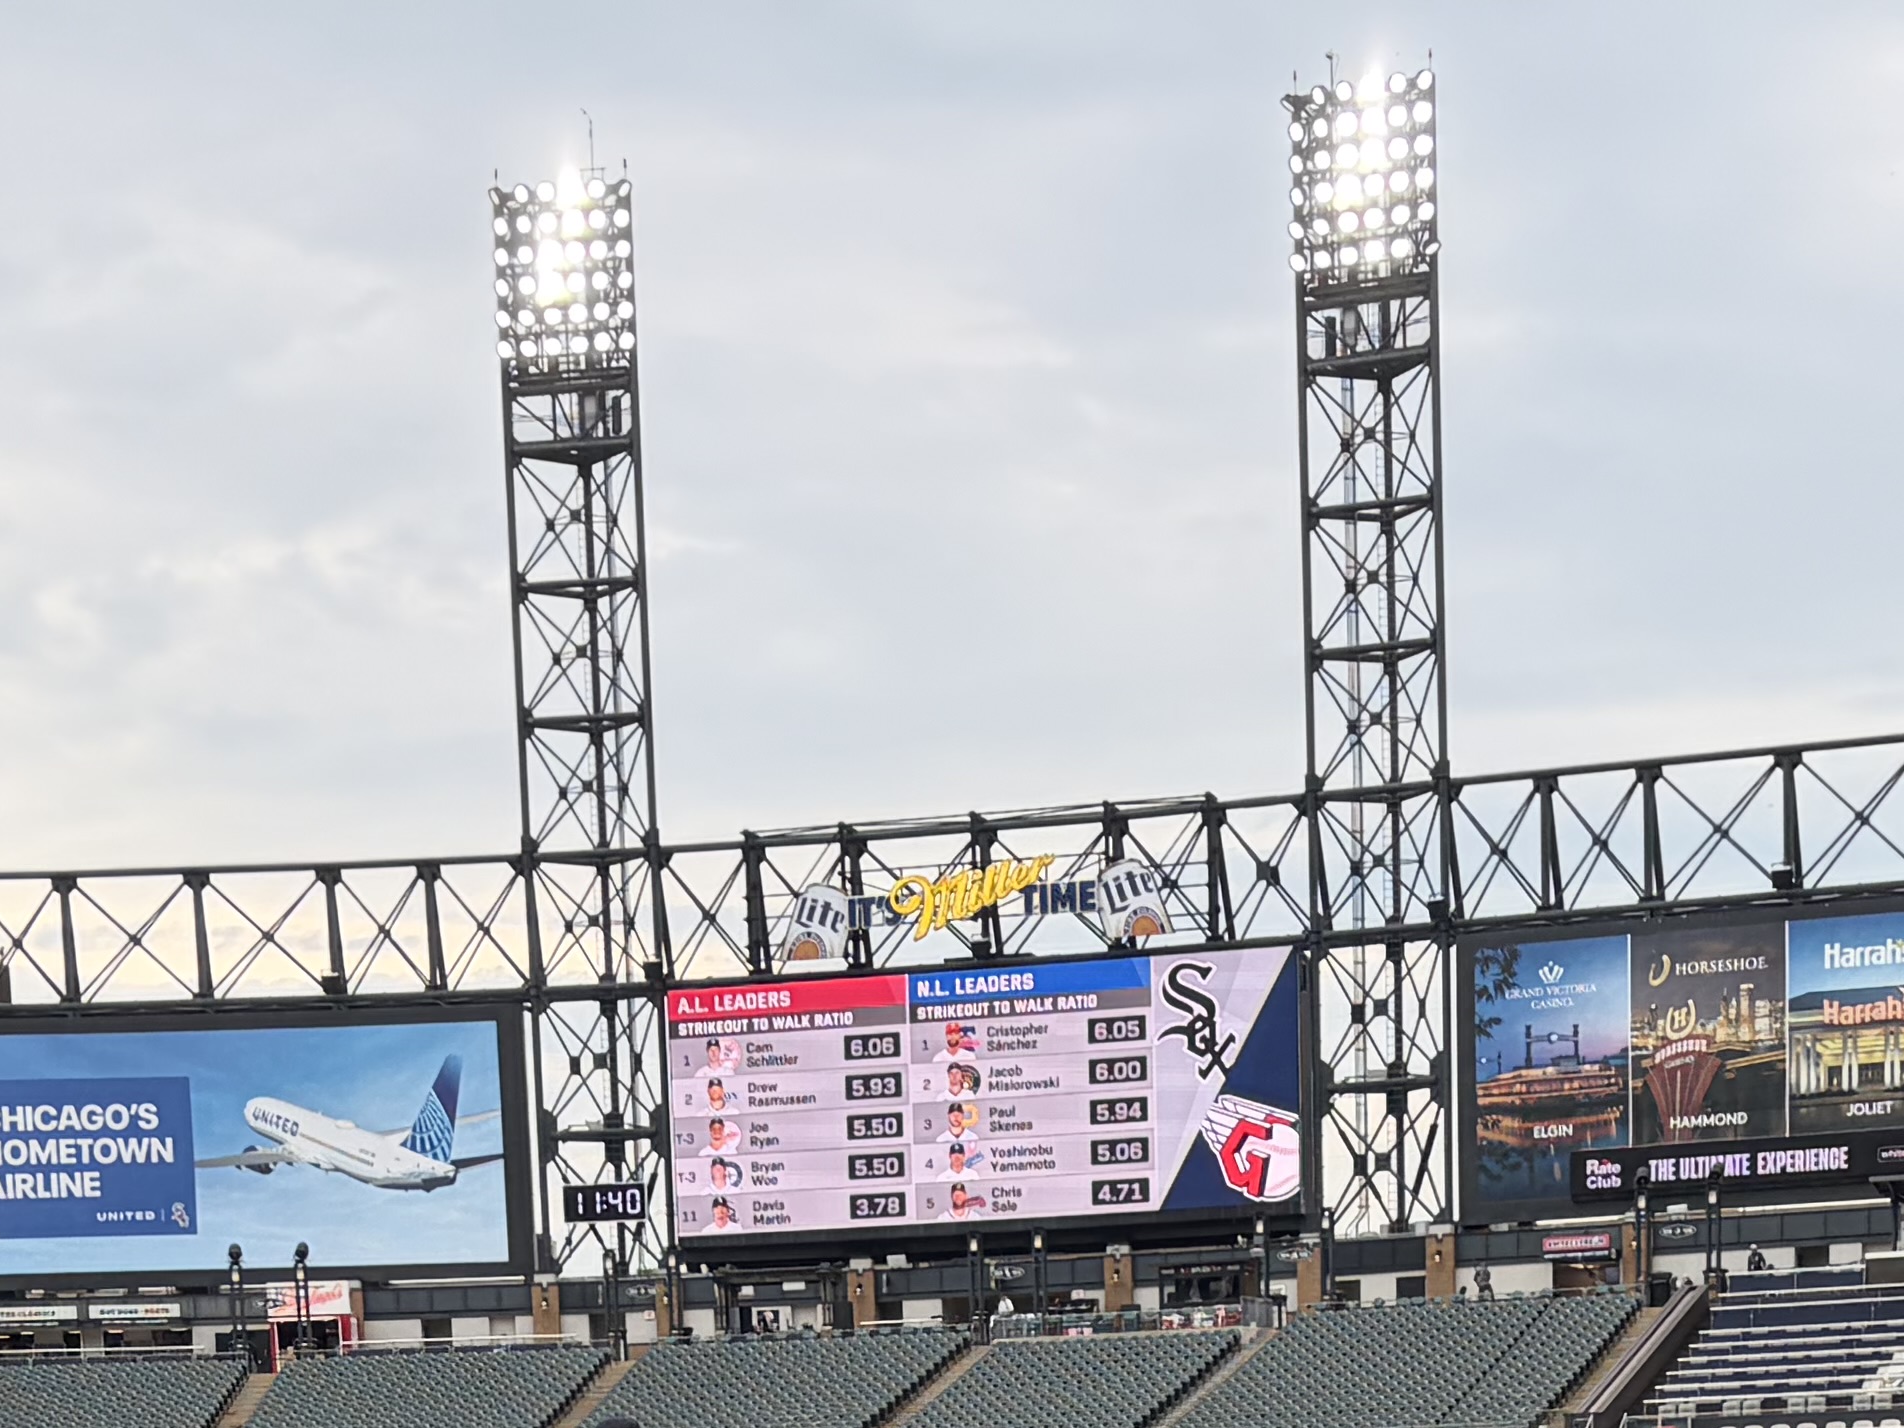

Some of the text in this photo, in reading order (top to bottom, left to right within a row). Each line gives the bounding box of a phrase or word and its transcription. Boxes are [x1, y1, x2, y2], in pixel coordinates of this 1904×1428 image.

[890, 853, 1055, 942] Miller
[1021, 880, 1097, 916] TIME
[1102, 870, 1154, 915] Lite
[794, 896, 845, 934] Lite
[1675, 956, 1767, 976] HORSESHOE
[917, 972, 1035, 998] N.L. LEADERS
[678, 990, 791, 1015] A.L. LEADERS
[917, 994, 1097, 1020] STRIKEOUT TO WALK RATIO
[678, 1011, 854, 1036] STRIKEOUT TO WALK RATIO
[1094, 1020, 1140, 1040] 6.05
[850, 1036, 895, 1057] 6.06
[1095, 1061, 1141, 1080] 6.00
[851, 1077, 896, 1097] 5.93
[1096, 1102, 1142, 1121] 5.94
[1846, 1101, 1892, 1117] JOLIET
[252, 1105, 300, 1138] UNITED
[853, 1117, 897, 1137] 5.50
[1533, 1124, 1573, 1138] ELGIN
[1670, 1112, 1747, 1130] HAMMOND
[1097, 1142, 1143, 1161] 5.06
[855, 1157, 899, 1176] 5.50
[1586, 1158, 1622, 1175] Rate
[1649, 1159, 1676, 1182] THE
[1757, 1146, 1849, 1174] EXPERIENCE
[1098, 1182, 1143, 1202] 4.71
[1586, 1175, 1622, 1190] Club
[578, 1189, 641, 1214] 11:40
[856, 1197, 900, 1216] 3.78
[97, 1210, 155, 1223] UNITED
